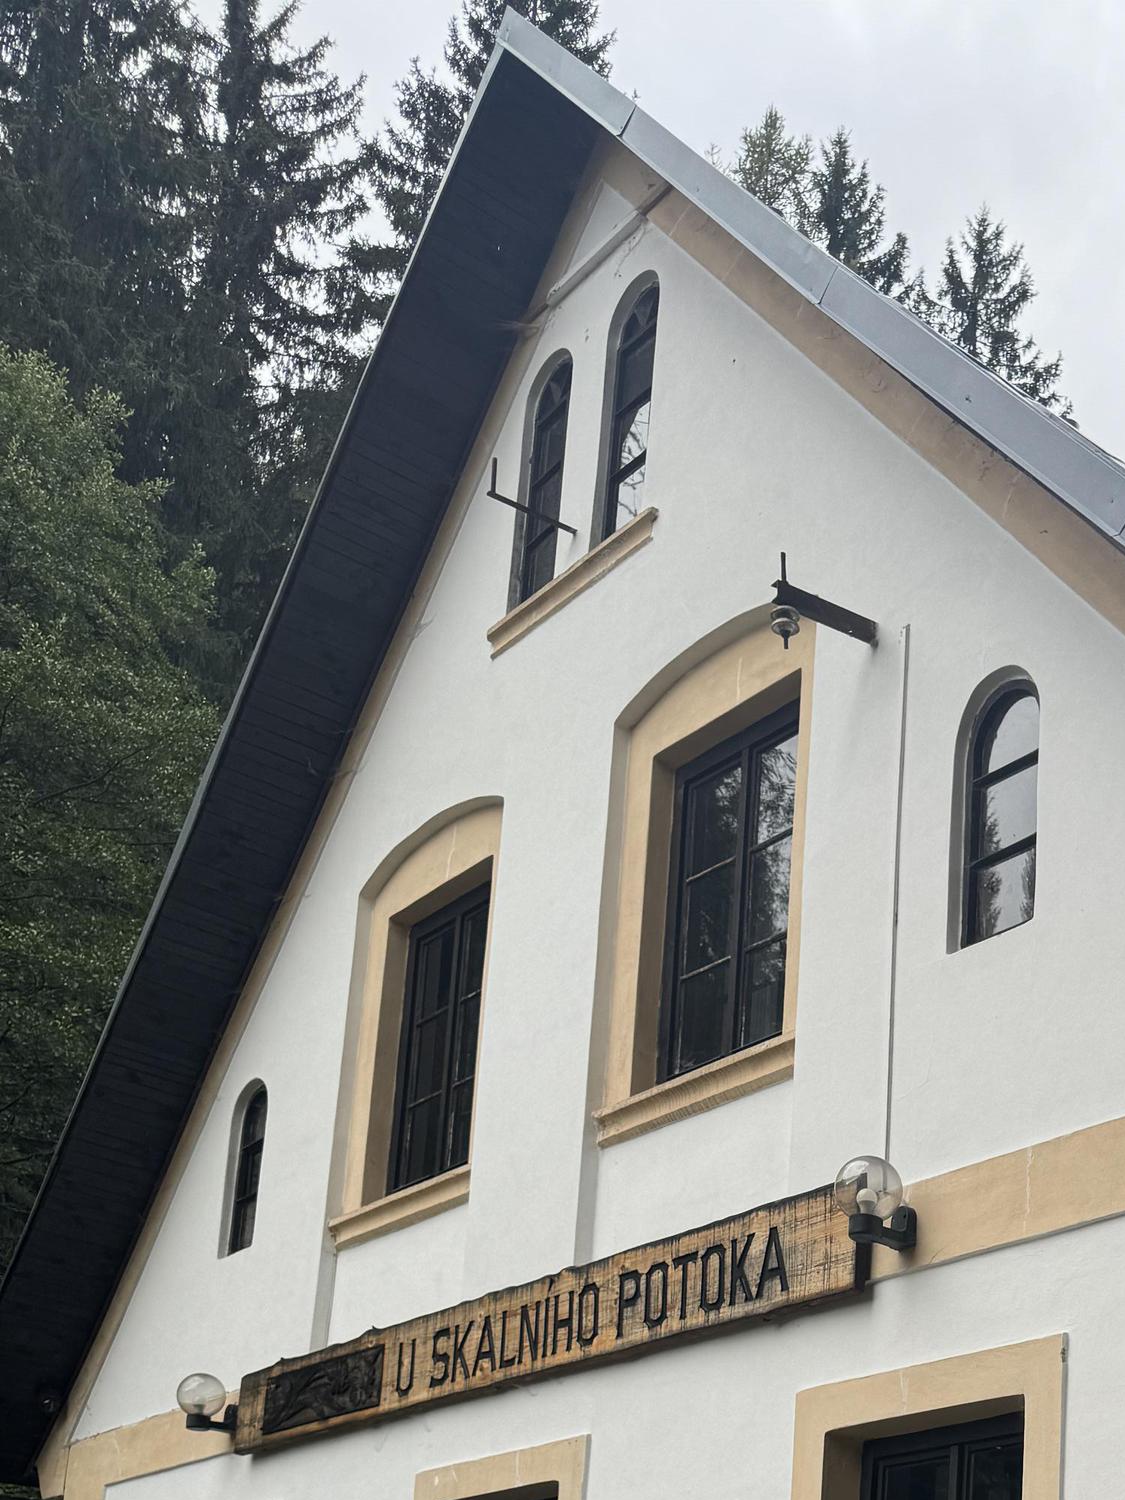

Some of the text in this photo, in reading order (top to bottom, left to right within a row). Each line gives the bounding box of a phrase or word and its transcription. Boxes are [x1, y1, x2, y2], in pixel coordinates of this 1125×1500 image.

[396, 1226, 789, 1397] U SKALNÍHO POTOKA
